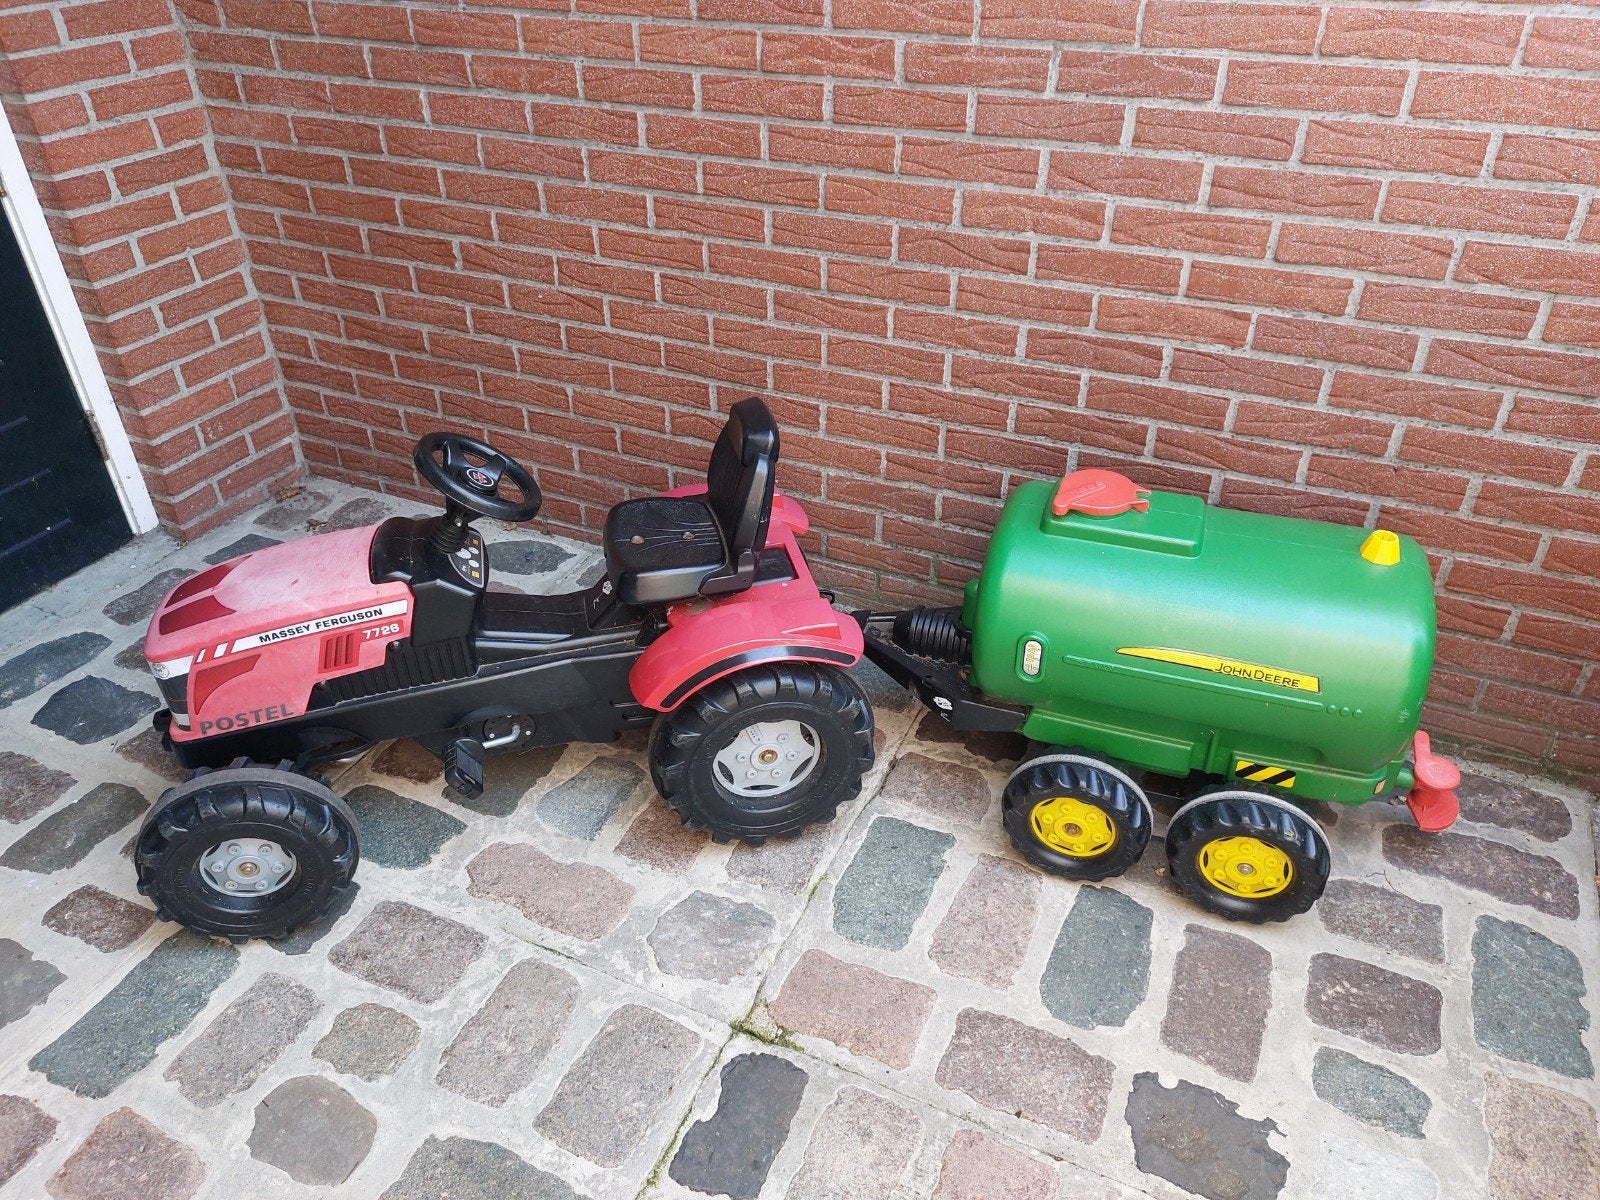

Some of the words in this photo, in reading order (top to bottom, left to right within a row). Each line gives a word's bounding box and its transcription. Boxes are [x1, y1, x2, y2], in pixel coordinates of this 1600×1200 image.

[258, 624, 311, 643] MASSEY
[315, 608, 383, 630] FERGUSON
[362, 623, 400, 640] 7726
[1214, 662, 1252, 680] JOHN
[1253, 669, 1300, 688] DEERE
[200, 704, 295, 735] POSTEL
